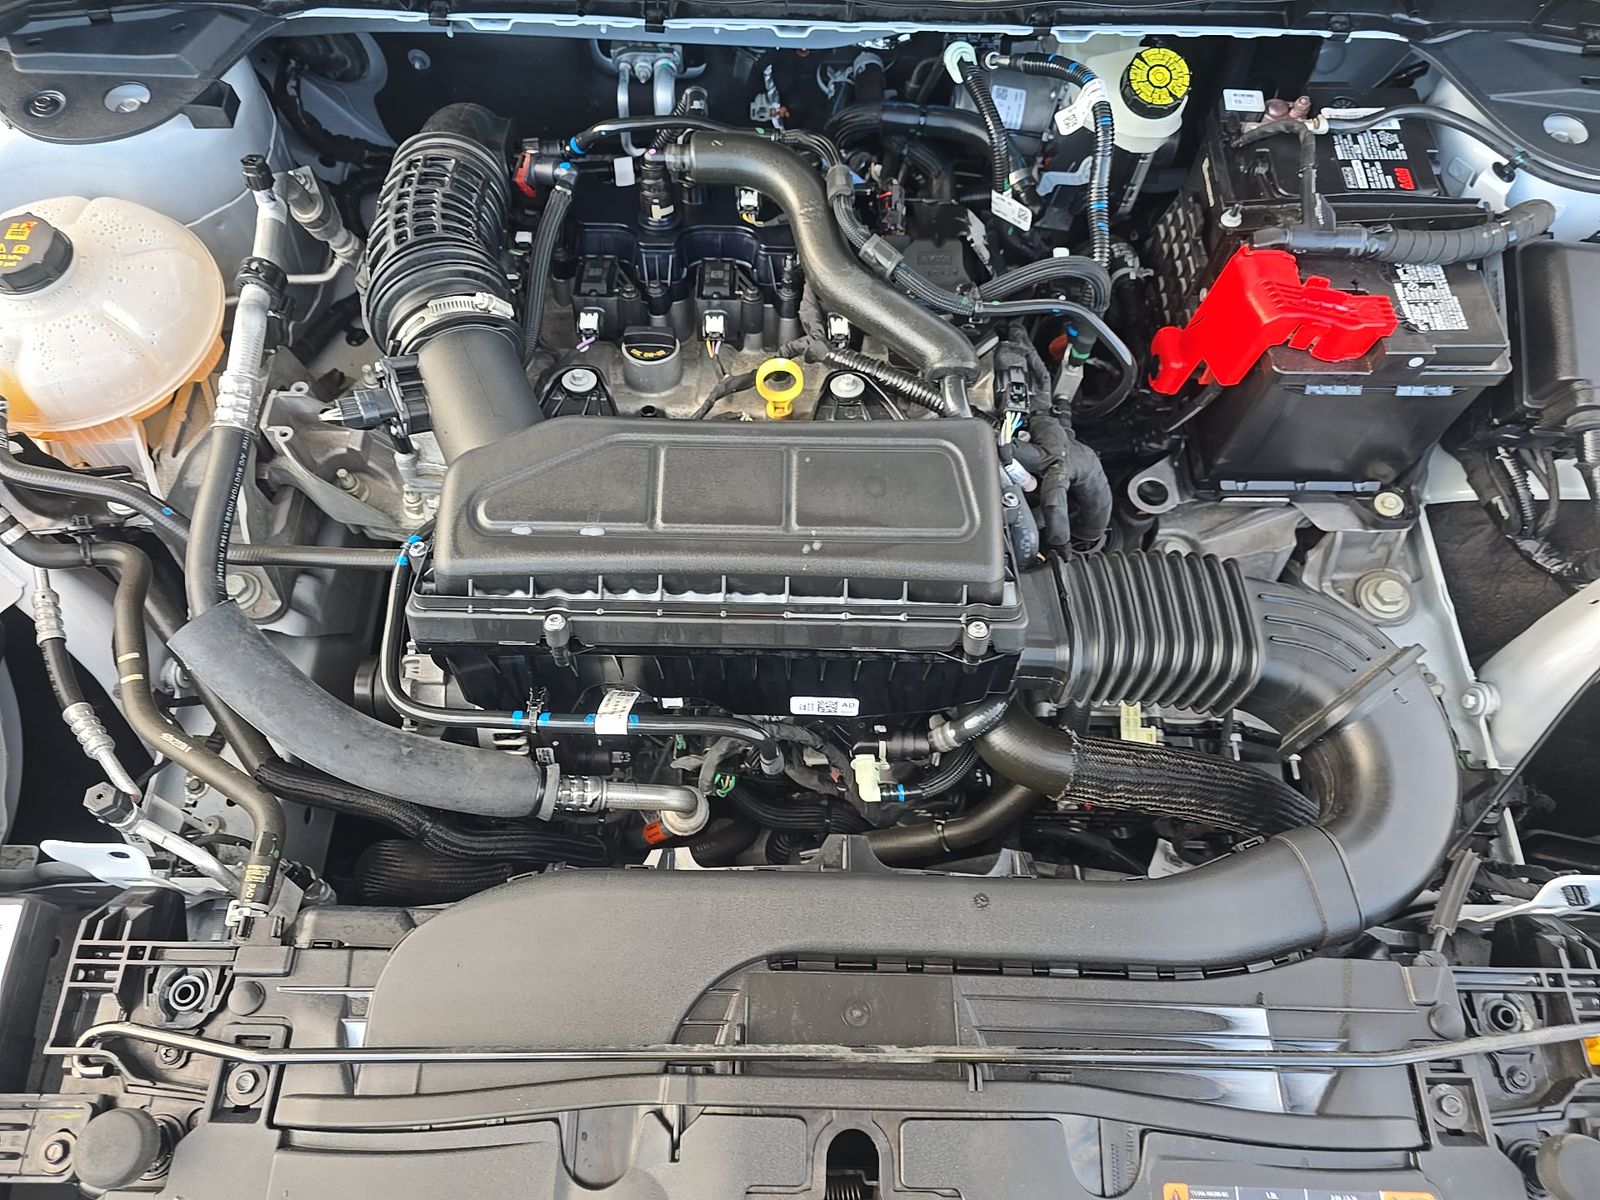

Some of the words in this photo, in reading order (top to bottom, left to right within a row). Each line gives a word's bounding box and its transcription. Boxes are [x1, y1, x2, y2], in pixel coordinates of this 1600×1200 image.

[230, 467, 244, 501] SUCTION
[224, 501, 235, 521] HOSE
[245, 883, 256, 898] RAD
